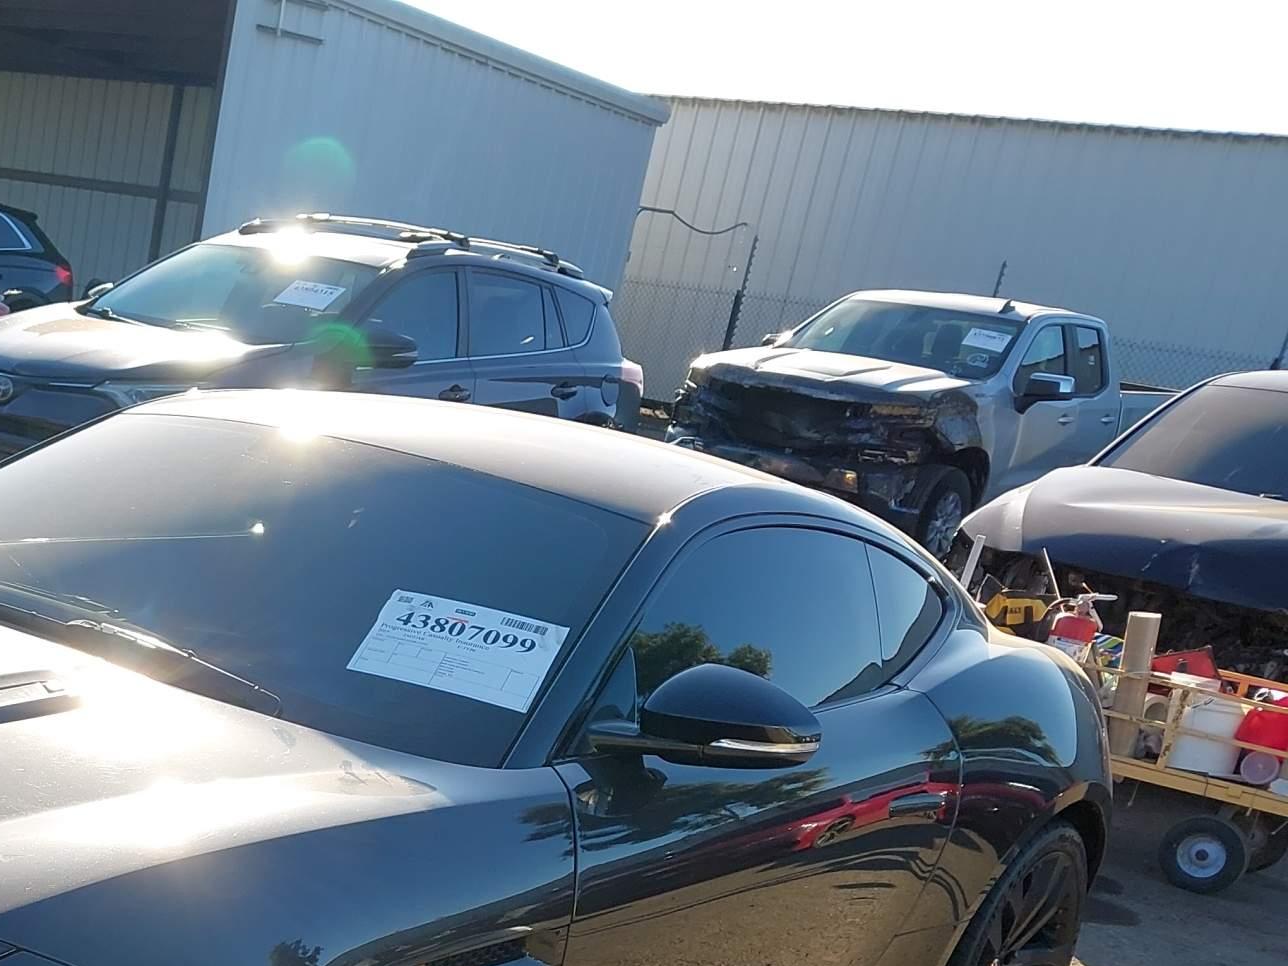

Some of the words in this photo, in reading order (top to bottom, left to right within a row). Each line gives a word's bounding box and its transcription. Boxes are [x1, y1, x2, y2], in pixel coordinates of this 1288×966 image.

[381, 622, 421, 635] Progressive
[455, 638, 490, 650] Insurance
[396, 611, 537, 654] 43807099
